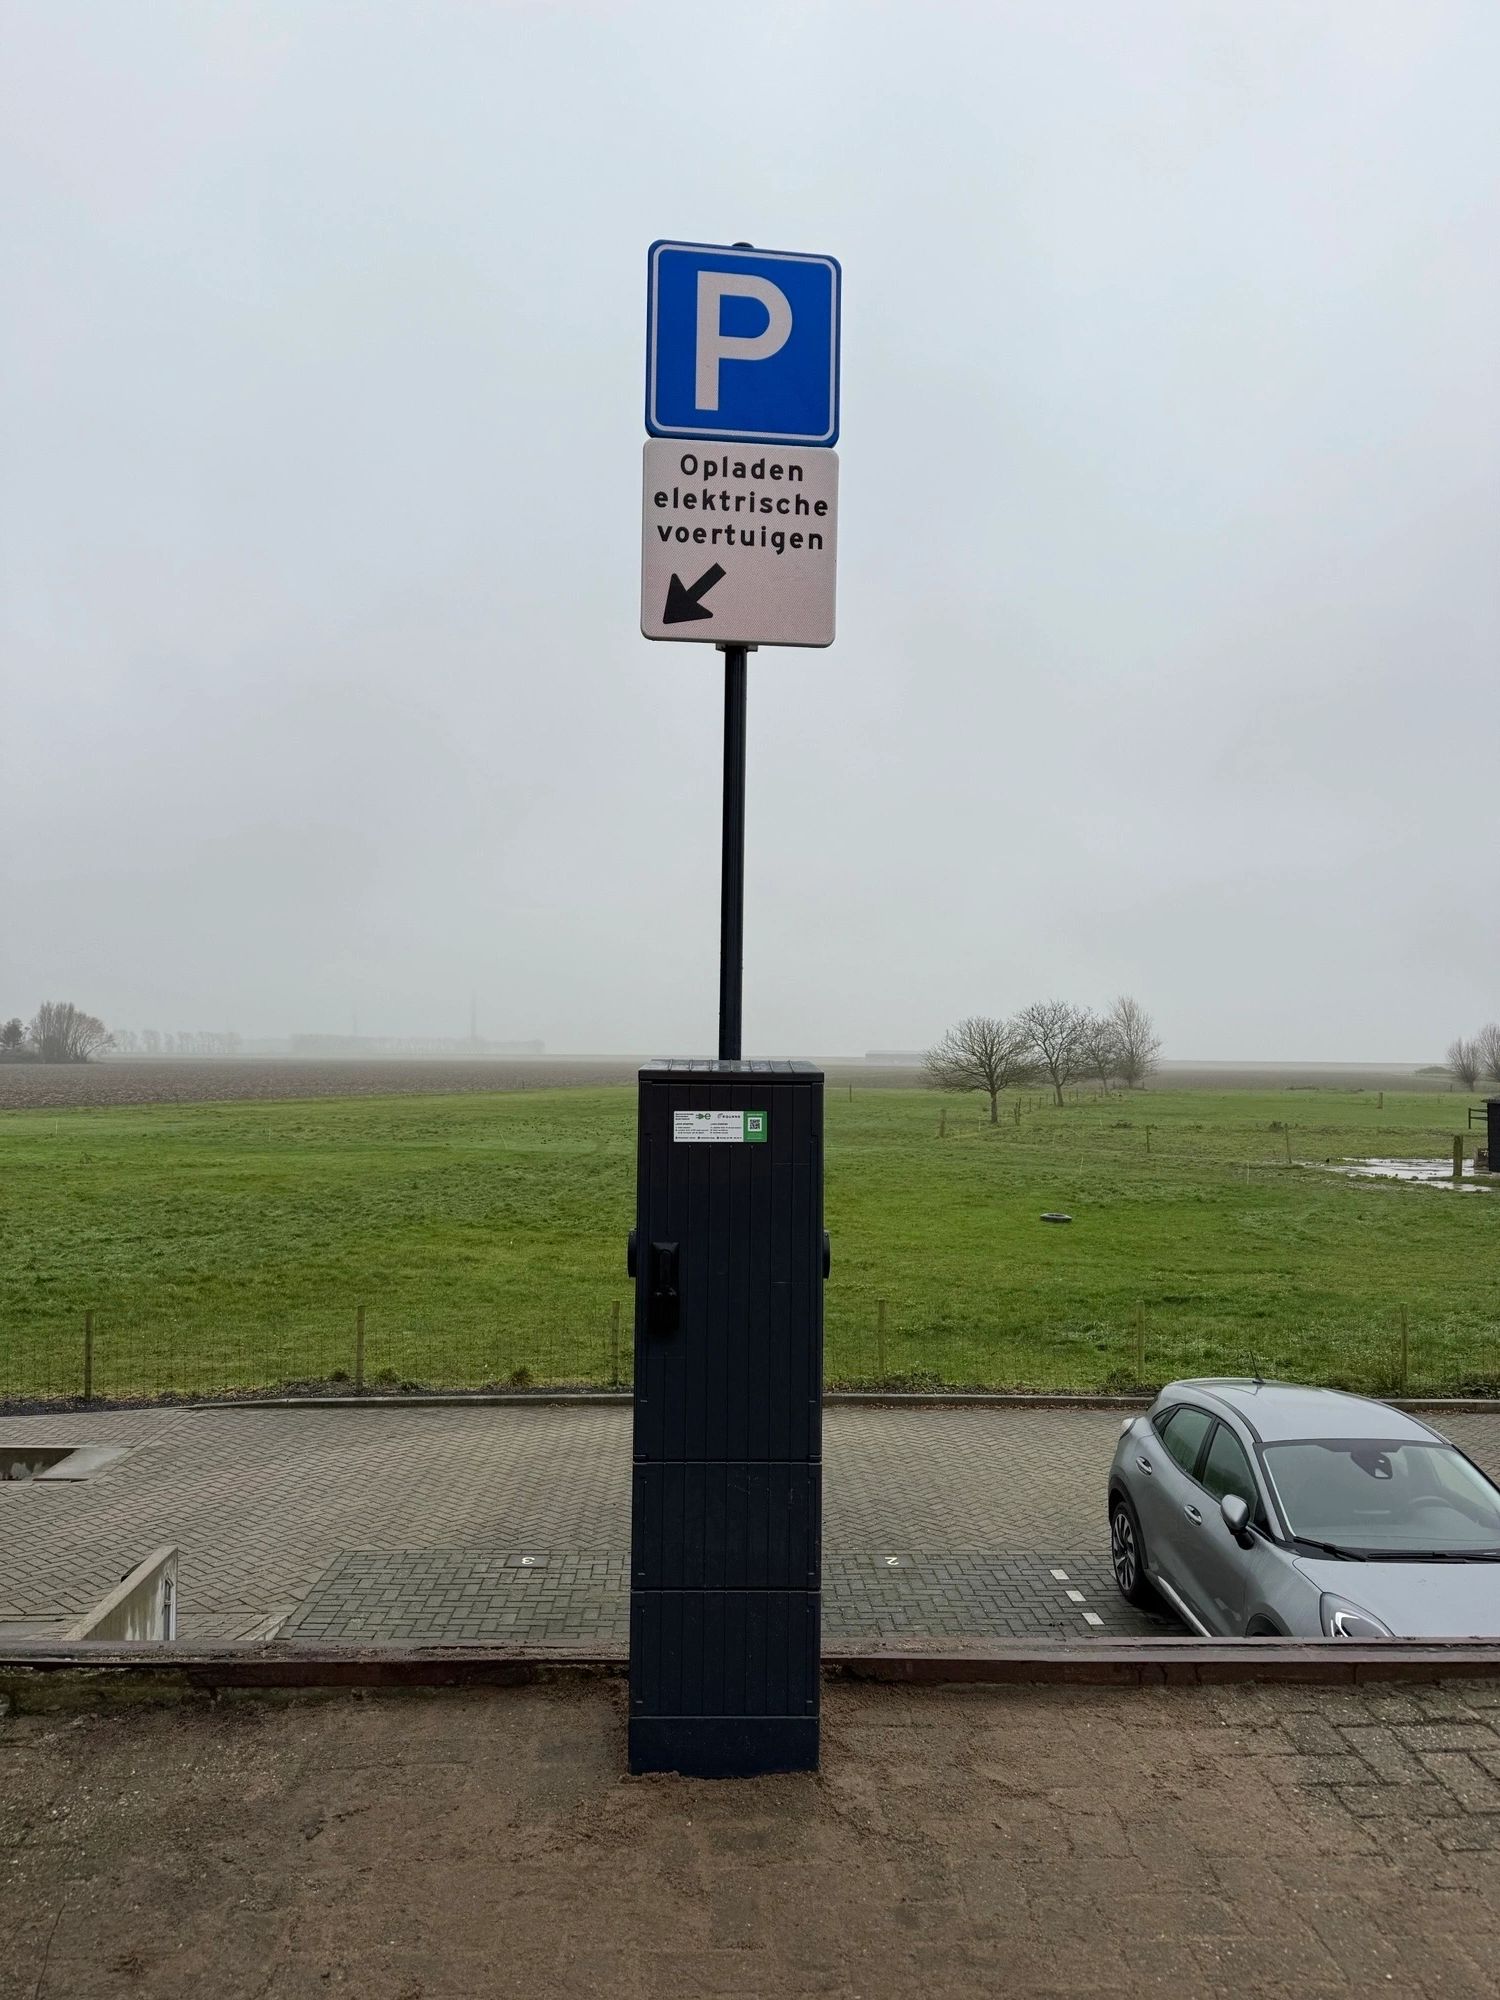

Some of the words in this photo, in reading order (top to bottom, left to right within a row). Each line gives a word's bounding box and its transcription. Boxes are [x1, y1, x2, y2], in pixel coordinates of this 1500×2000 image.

[695, 270, 793, 411] P
[680, 453, 803, 482] Opladen
[653, 486, 829, 517] elektrische
[656, 523, 823, 556] voertuigen
